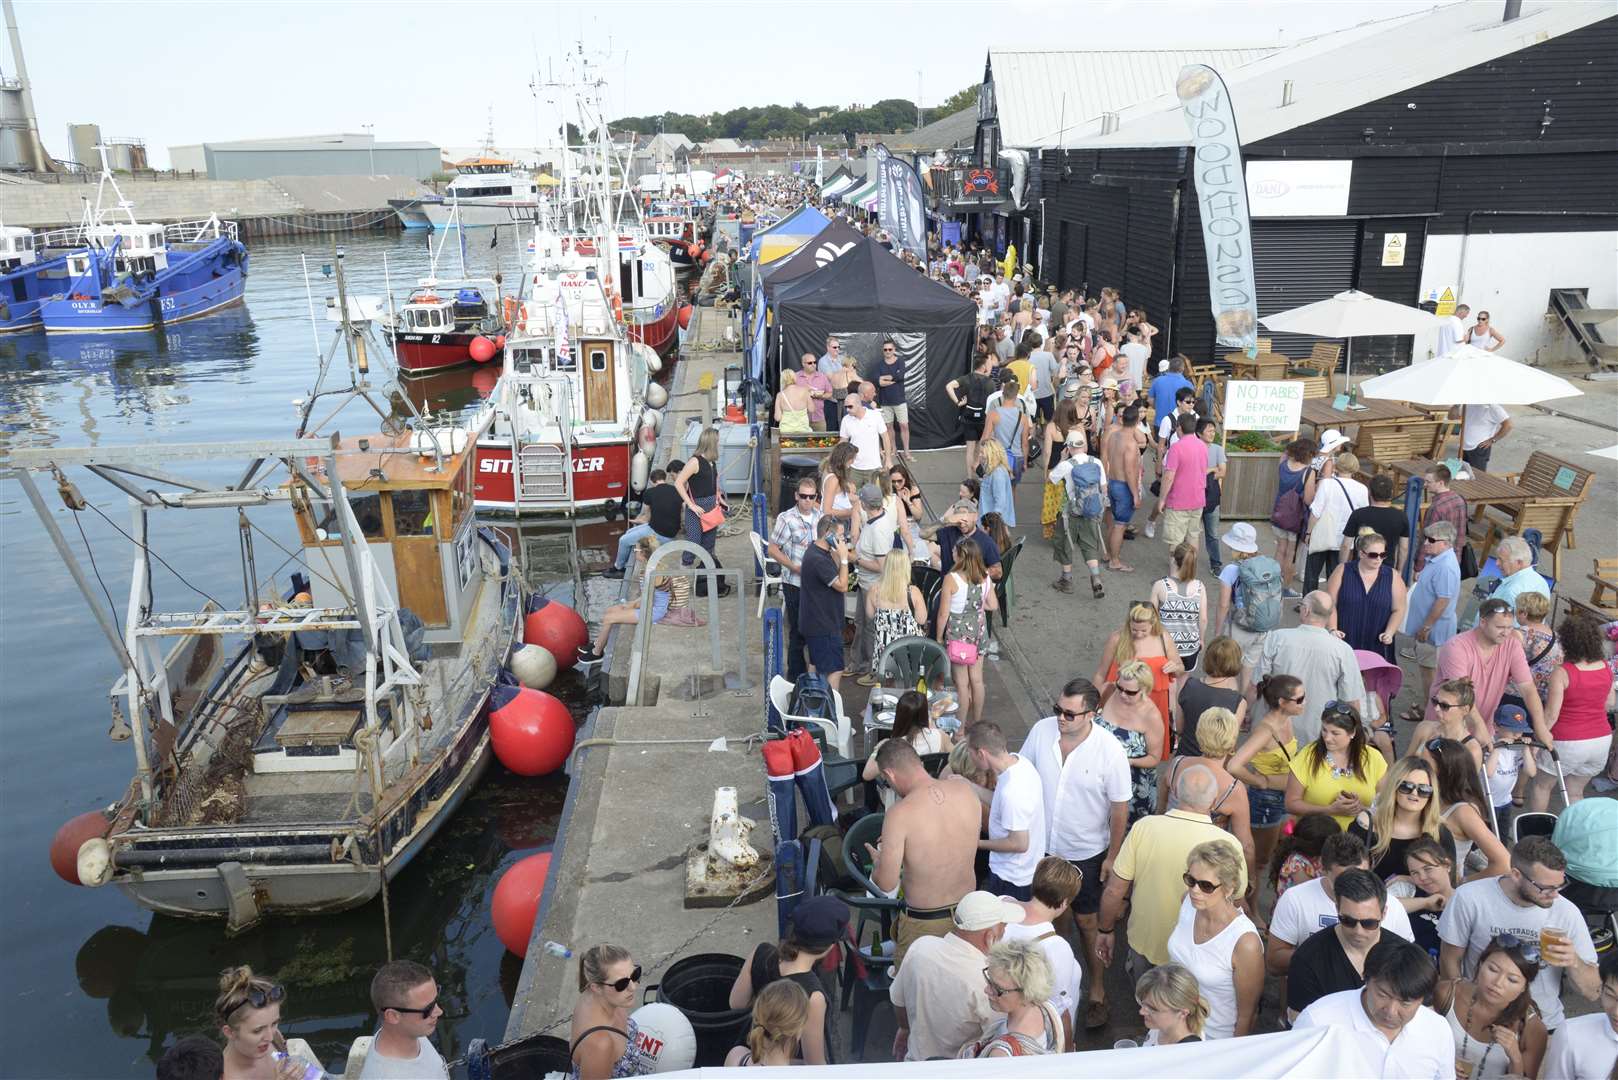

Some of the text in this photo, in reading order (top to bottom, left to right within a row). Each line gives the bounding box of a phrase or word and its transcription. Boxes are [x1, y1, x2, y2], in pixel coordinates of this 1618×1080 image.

[1236, 384, 1299, 400] NO TABLES
[1246, 402, 1286, 413] BEYOND
[1236, 415, 1288, 425] THIS POINT
[635, 1031, 664, 1057] ENT
